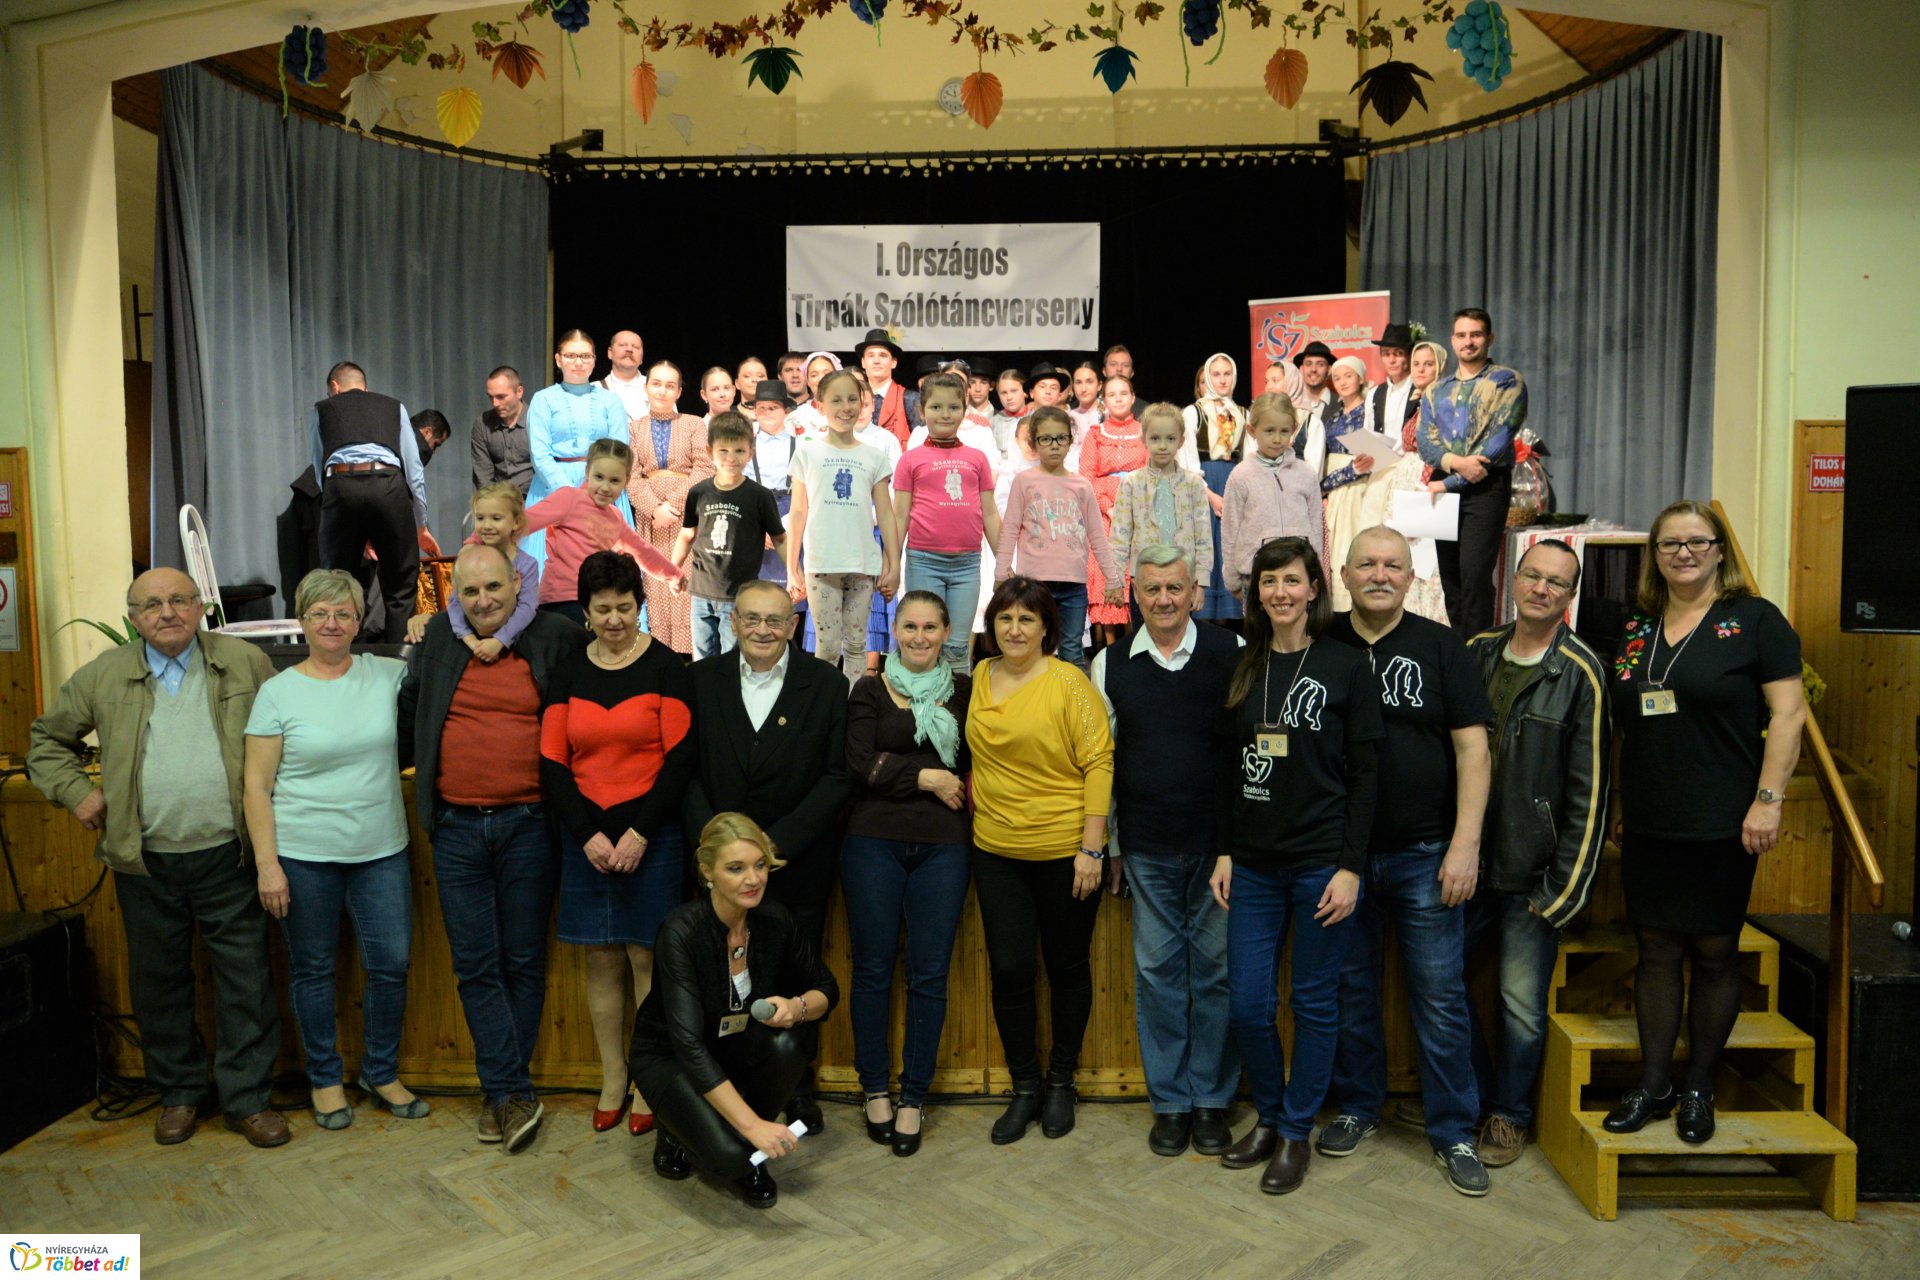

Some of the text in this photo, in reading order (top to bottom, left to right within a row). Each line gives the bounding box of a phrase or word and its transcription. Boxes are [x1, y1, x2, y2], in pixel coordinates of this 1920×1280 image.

[876, 241, 1009, 280] I. Országos
[791, 292, 1094, 331] Tirpák Szólótáncverseny
[1814, 459, 1839, 469] TILOS
[705, 502, 739, 511] Szabolcs
[1243, 784, 1270, 795] Szabolcs
